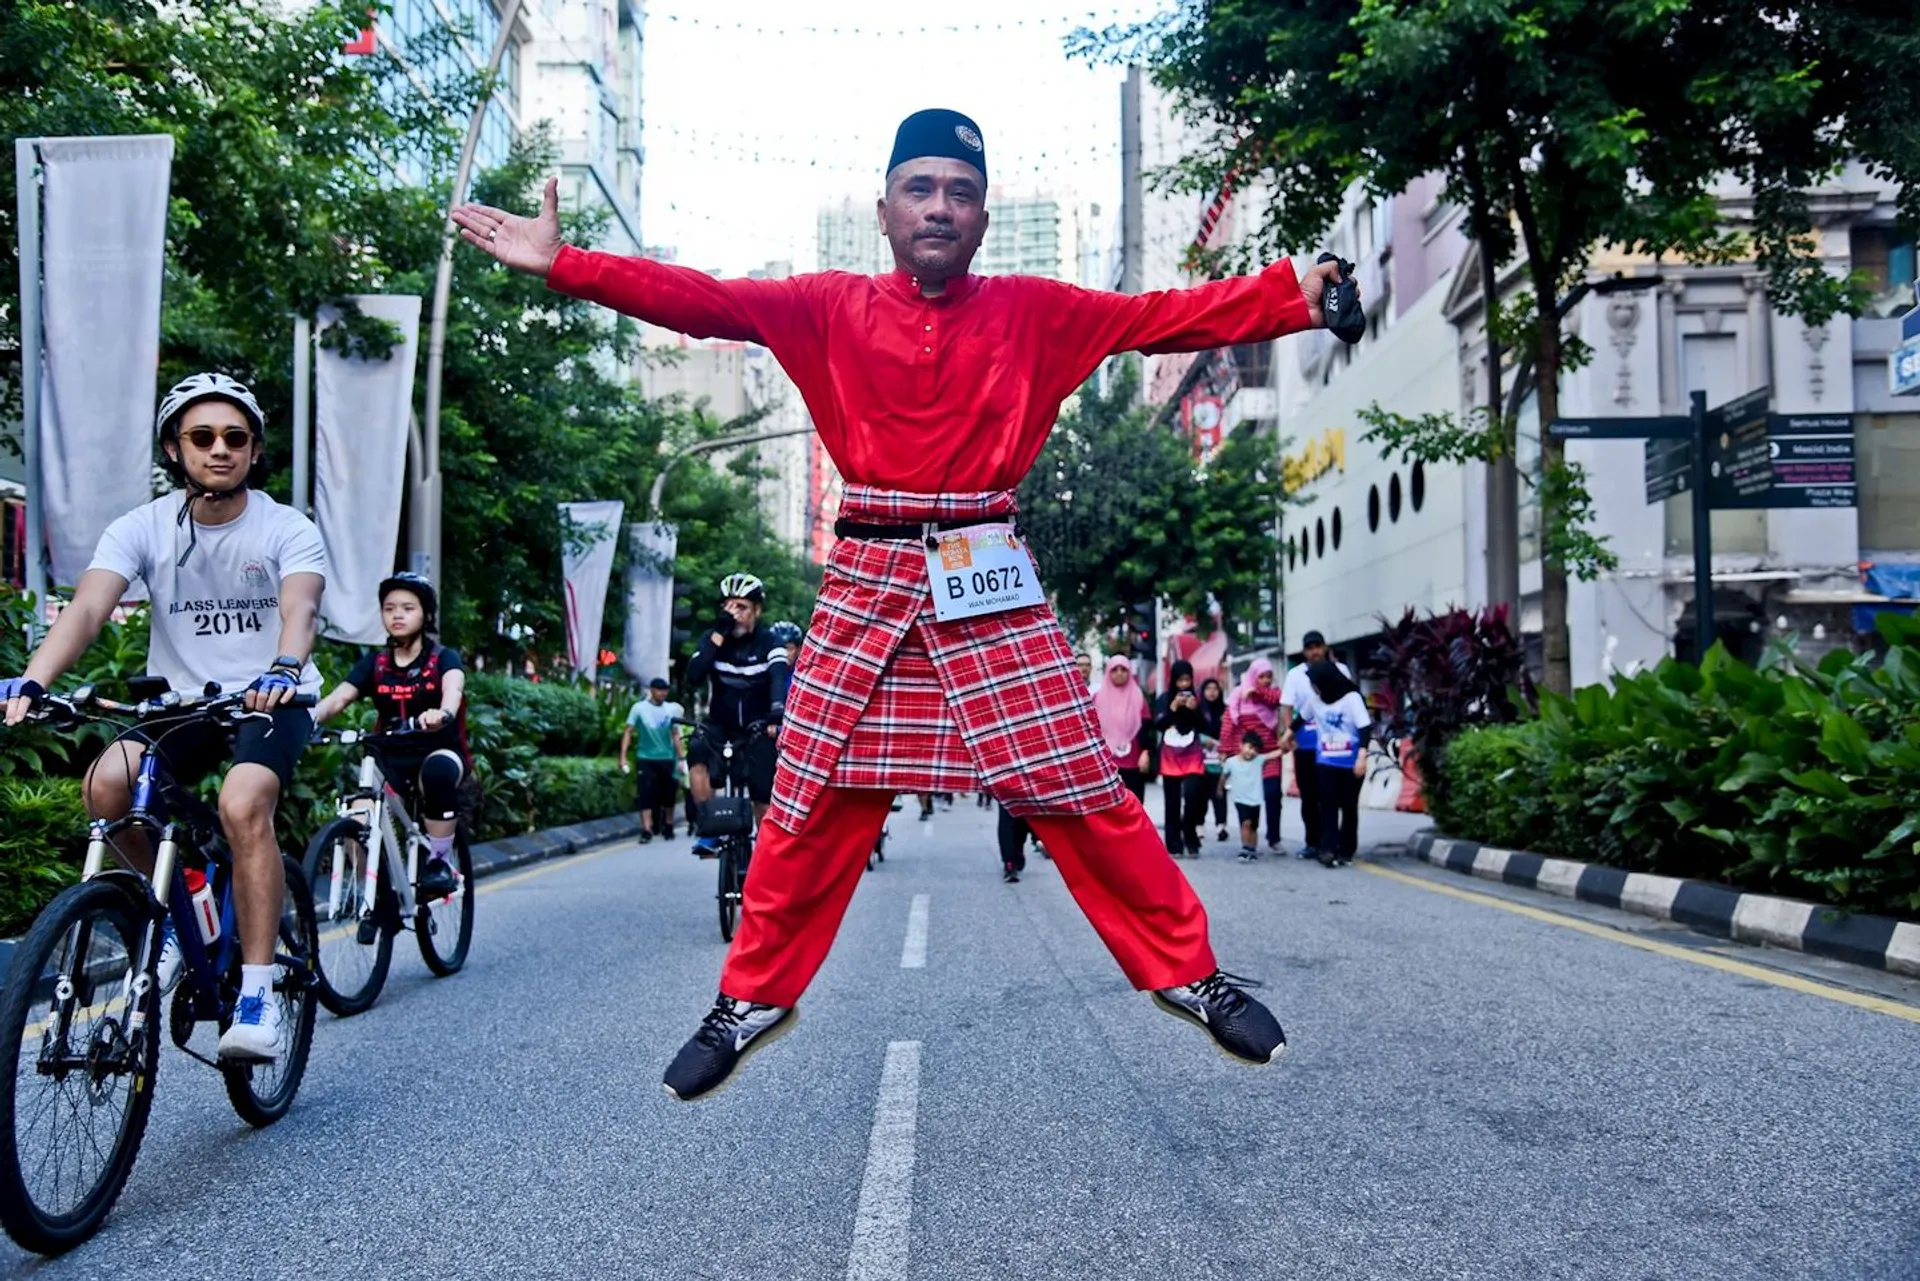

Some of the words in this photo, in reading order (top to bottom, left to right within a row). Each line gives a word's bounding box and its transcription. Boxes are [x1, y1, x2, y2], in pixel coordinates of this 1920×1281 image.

[946, 576, 965, 600] B
[972, 565, 1023, 595] 0672
[218, 597, 279, 610] LEAVERS
[968, 600, 985, 608] WAN
[986, 594, 1020, 606] MOHAMAD
[194, 612, 262, 636] 2014
